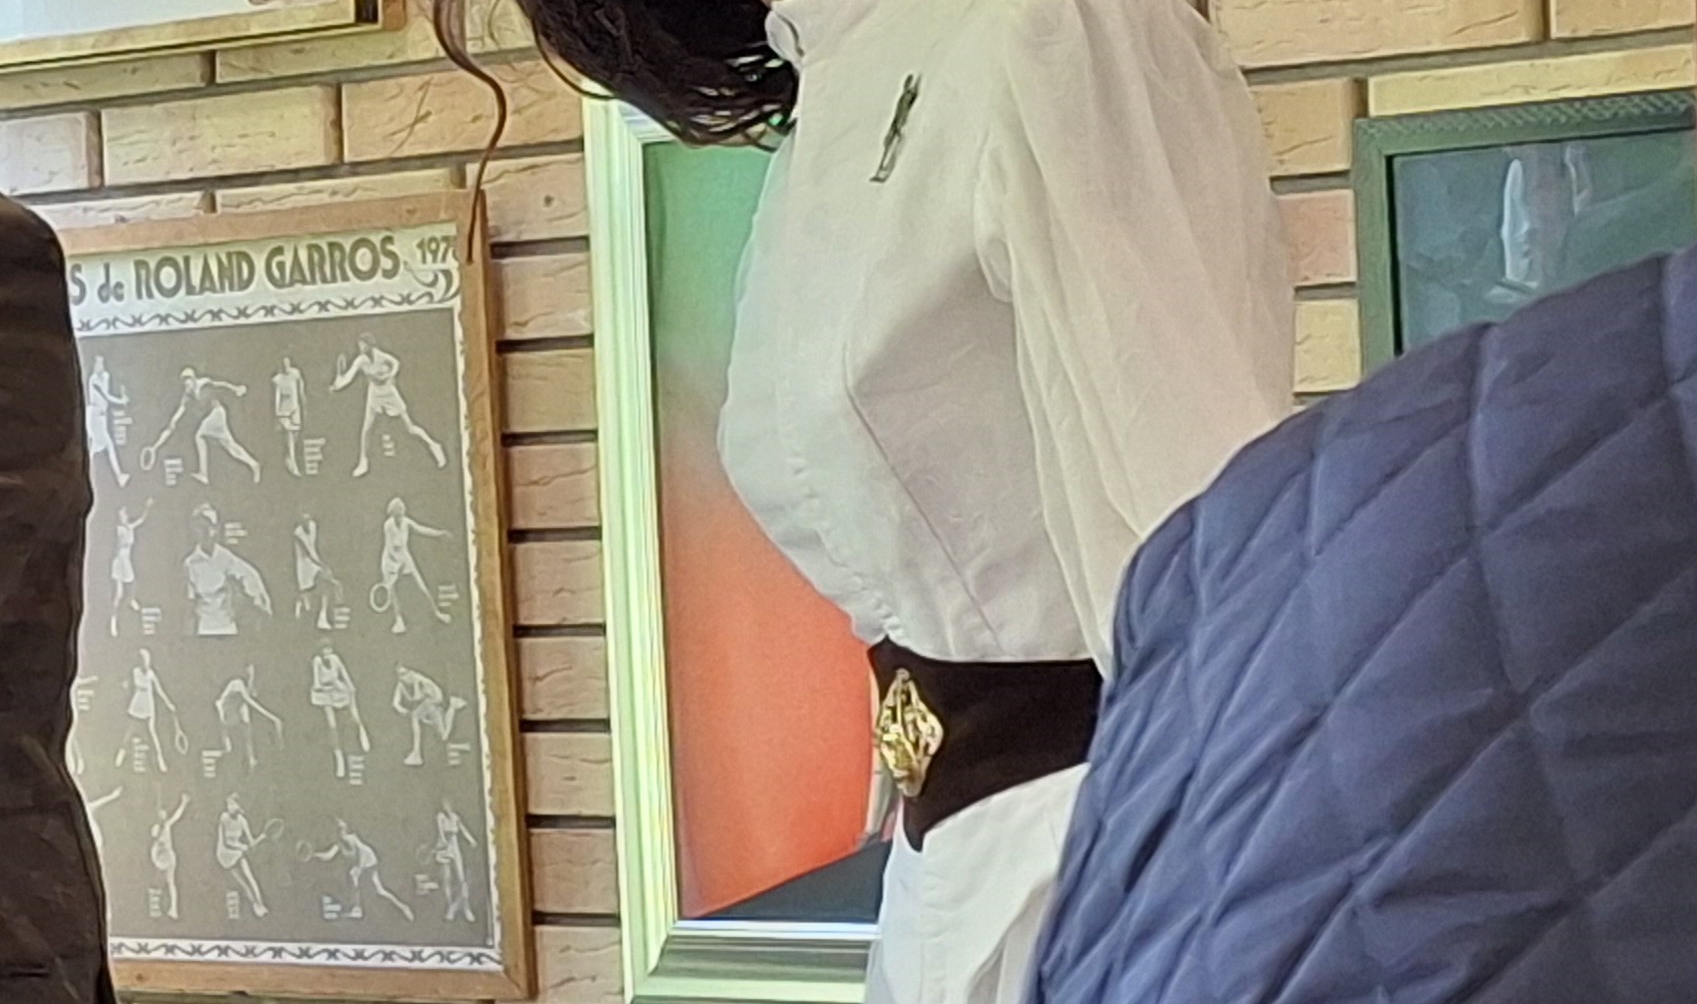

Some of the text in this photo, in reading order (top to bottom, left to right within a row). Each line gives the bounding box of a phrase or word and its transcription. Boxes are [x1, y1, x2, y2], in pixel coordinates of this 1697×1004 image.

[97, 262, 125, 304] de
[133, 250, 256, 300] ROLAND
[265, 235, 401, 289] GARROS
